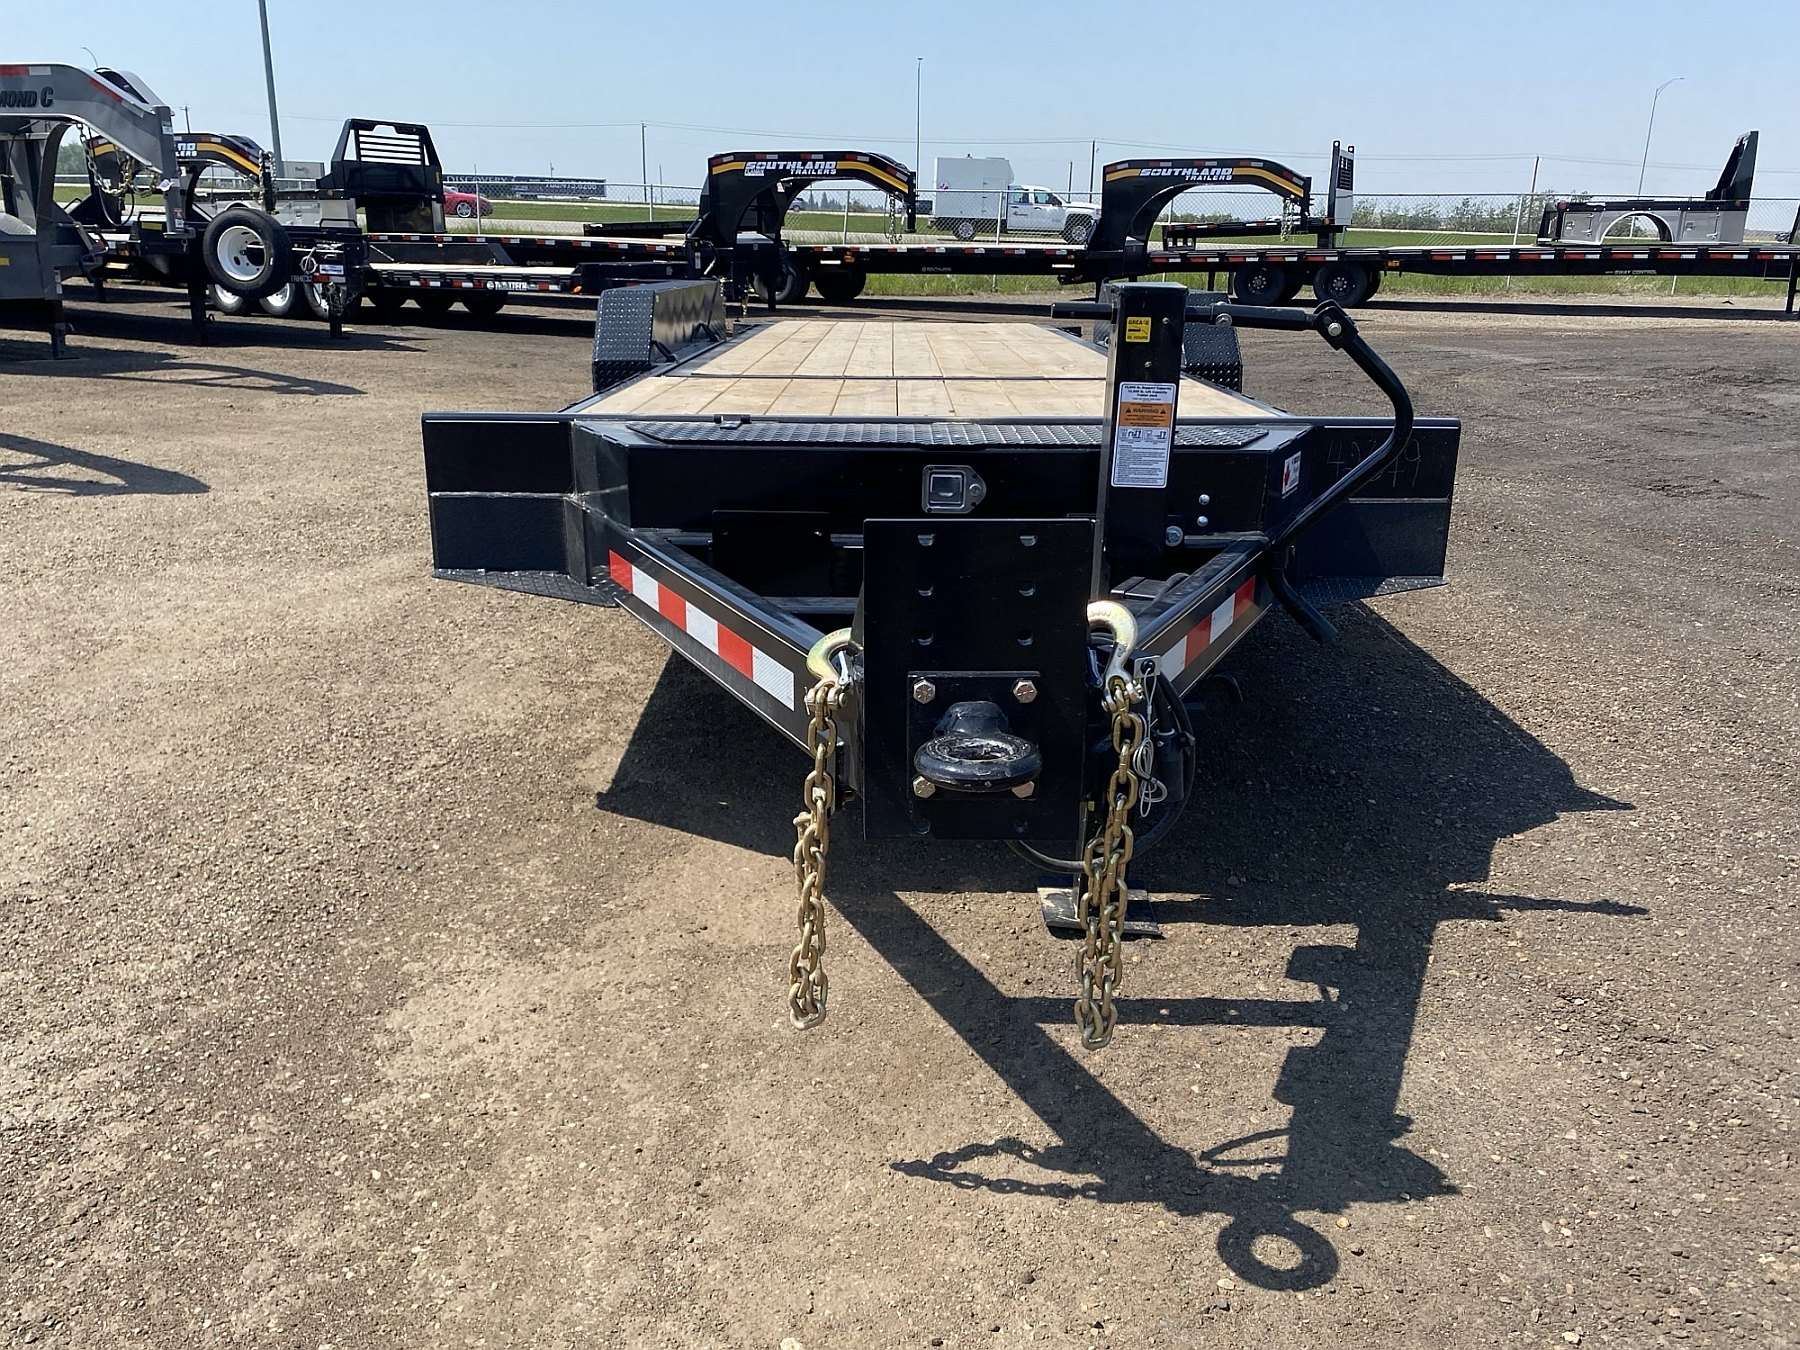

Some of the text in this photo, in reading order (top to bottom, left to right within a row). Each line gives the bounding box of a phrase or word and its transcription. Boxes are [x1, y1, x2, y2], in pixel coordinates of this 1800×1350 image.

[40, 86, 54, 108] C
[745, 161, 837, 170] SOUTHLAND
[1140, 167, 1233, 177] SOUTHLAND
